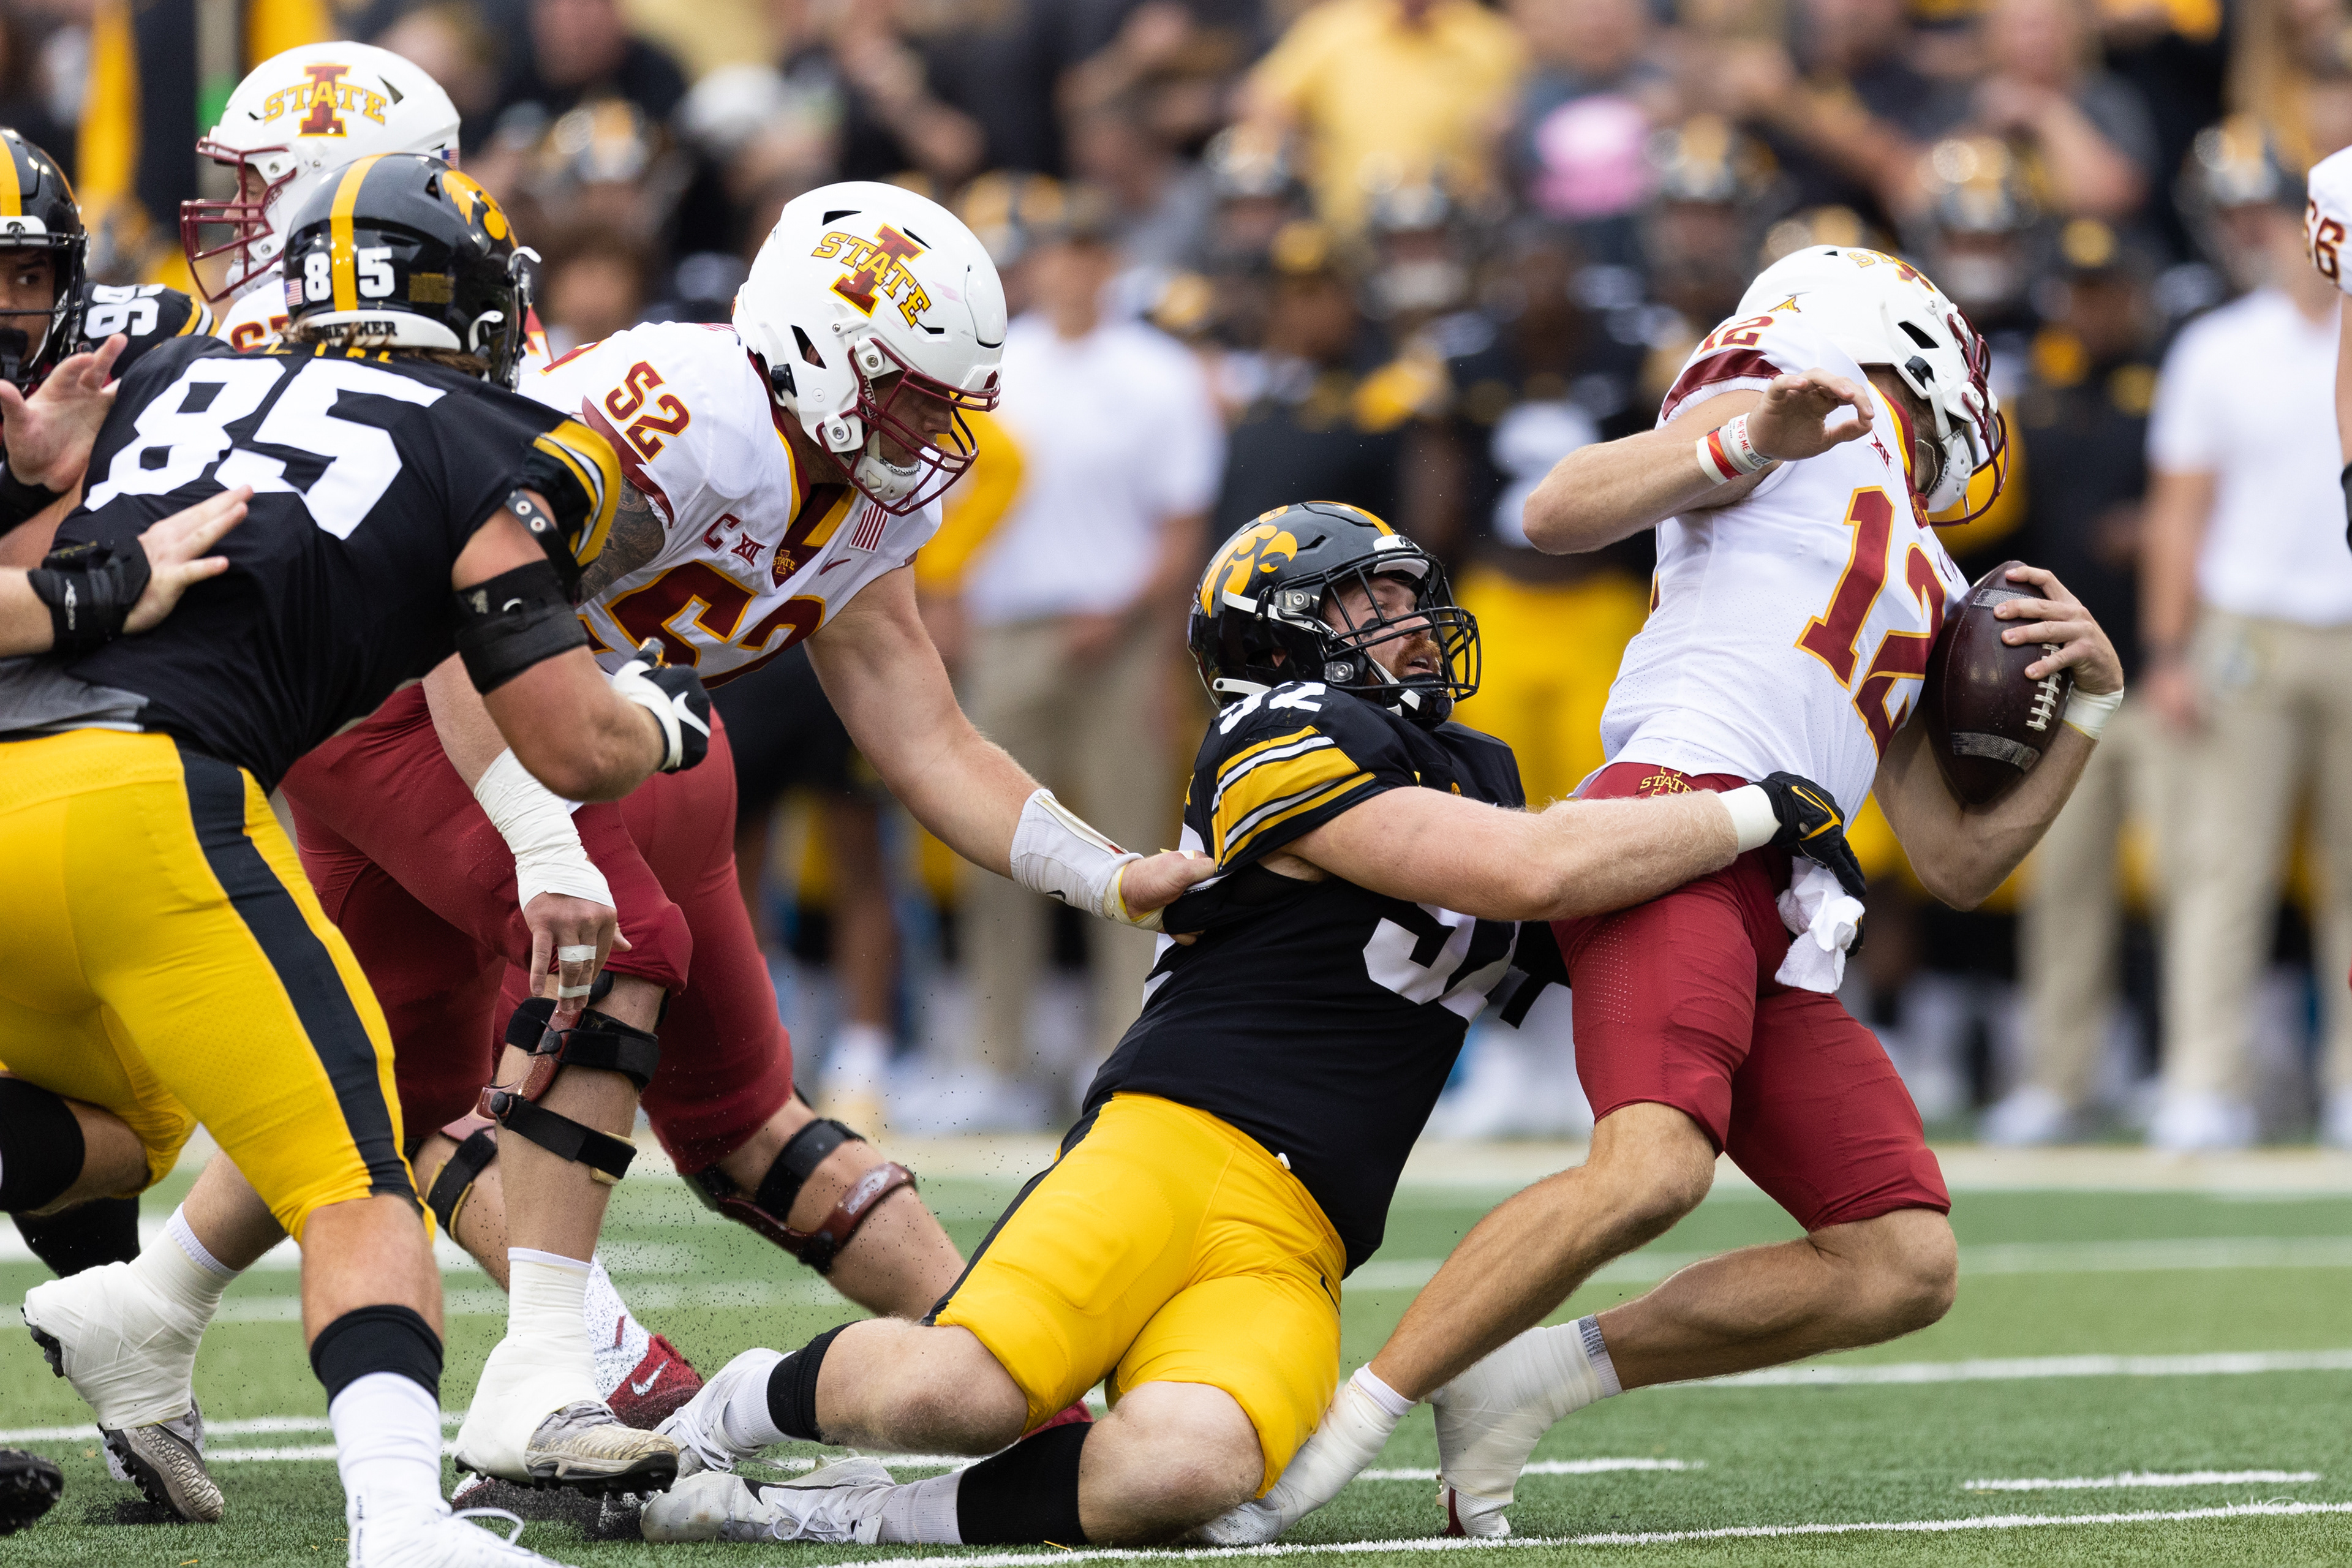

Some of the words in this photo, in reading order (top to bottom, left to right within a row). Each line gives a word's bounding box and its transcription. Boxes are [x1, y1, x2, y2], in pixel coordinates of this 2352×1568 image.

[263, 80, 387, 126] STATE
[810, 231, 932, 330] STATE
[1697, 315, 1775, 356] 12
[604, 360, 691, 464] 52
[83, 354, 448, 540] 85
[1741, 439, 1751, 451] ME
[701, 511, 744, 553] C
[730, 531, 768, 568] XII
[772, 556, 796, 571] STATE
[1793, 486, 1947, 767] 12
